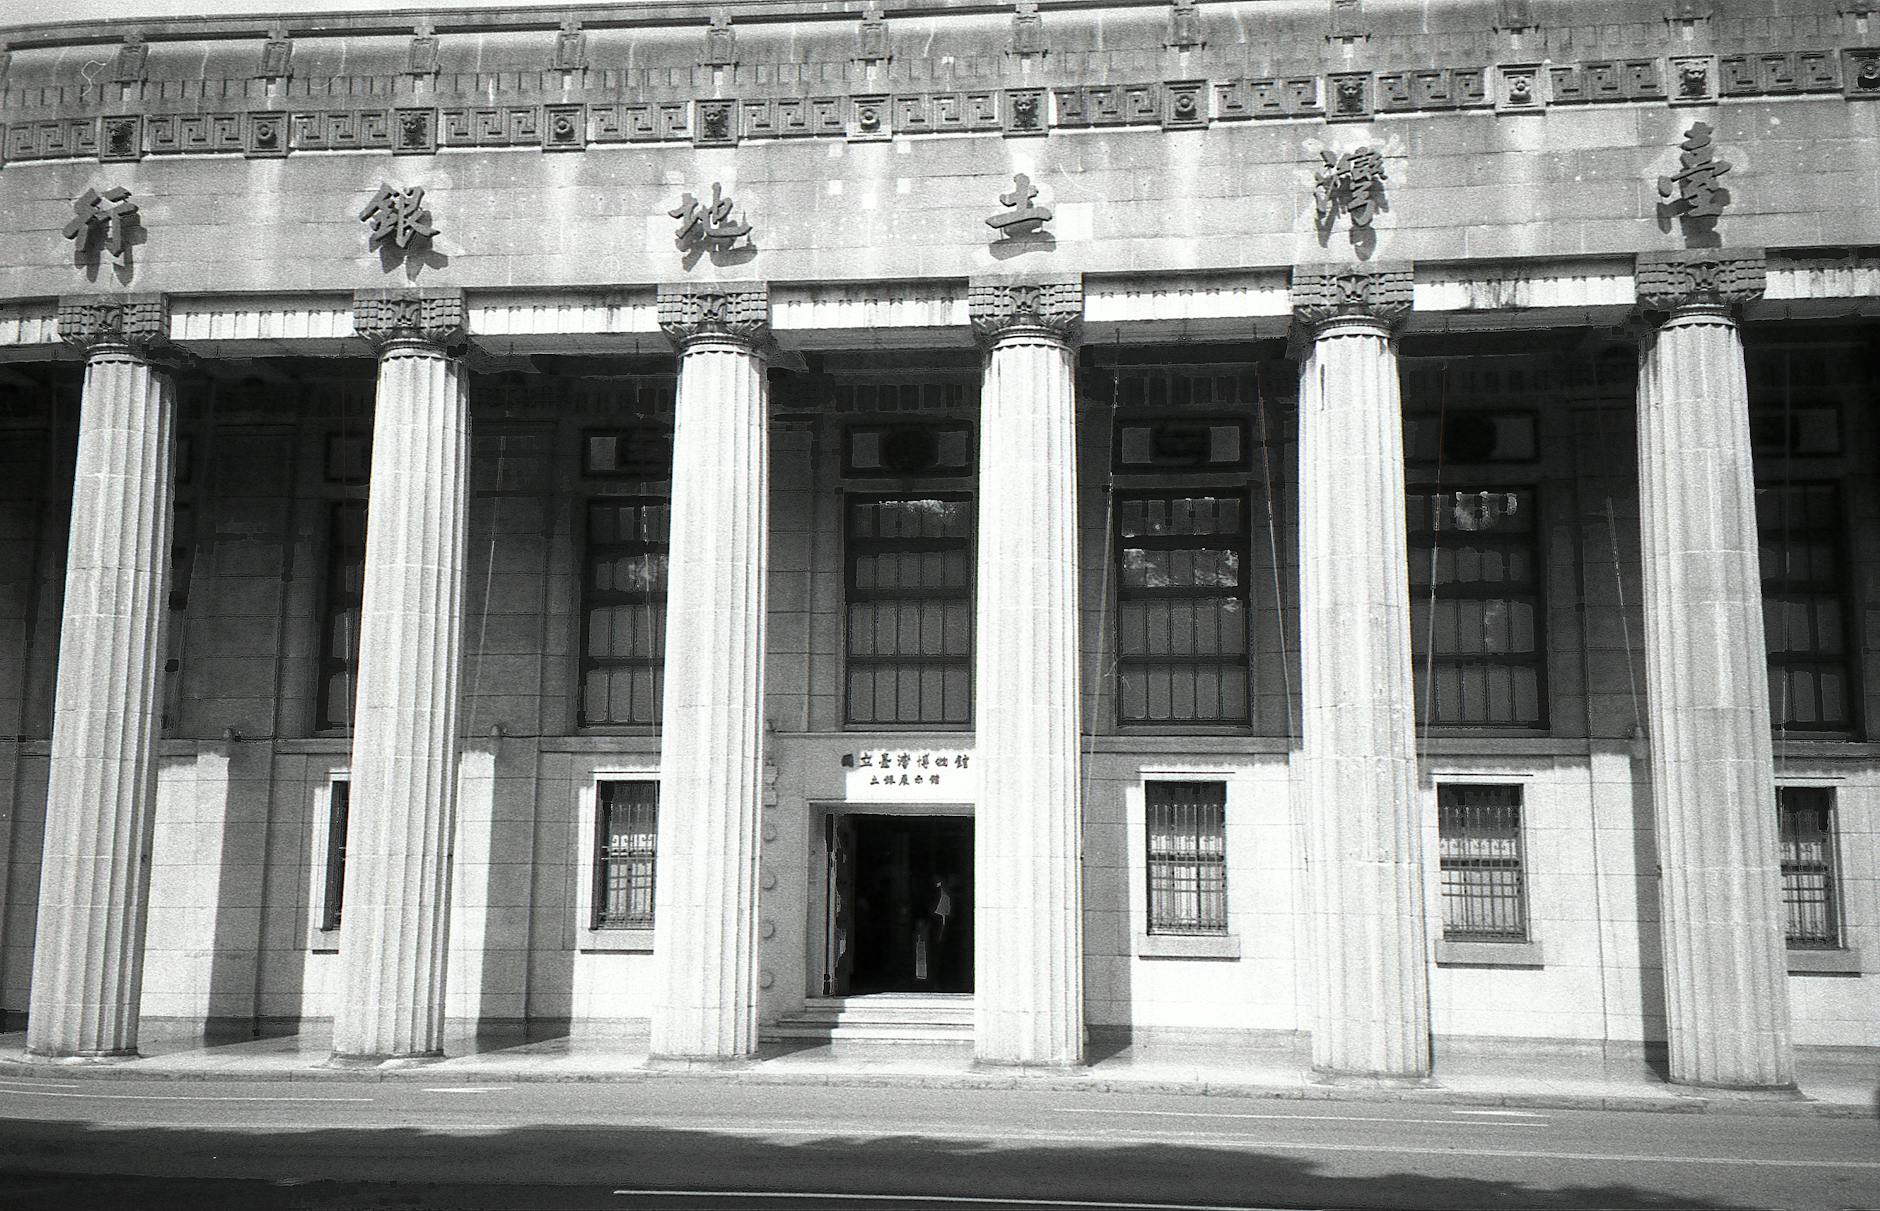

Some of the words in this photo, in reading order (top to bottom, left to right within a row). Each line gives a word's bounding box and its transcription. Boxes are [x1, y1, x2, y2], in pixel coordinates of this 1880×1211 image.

[359, 183, 441, 248] 銀
[668, 181, 753, 239] 地
[985, 172, 1054, 229] 土
[1314, 146, 1389, 227] 灣
[62, 185, 140, 257] 行
